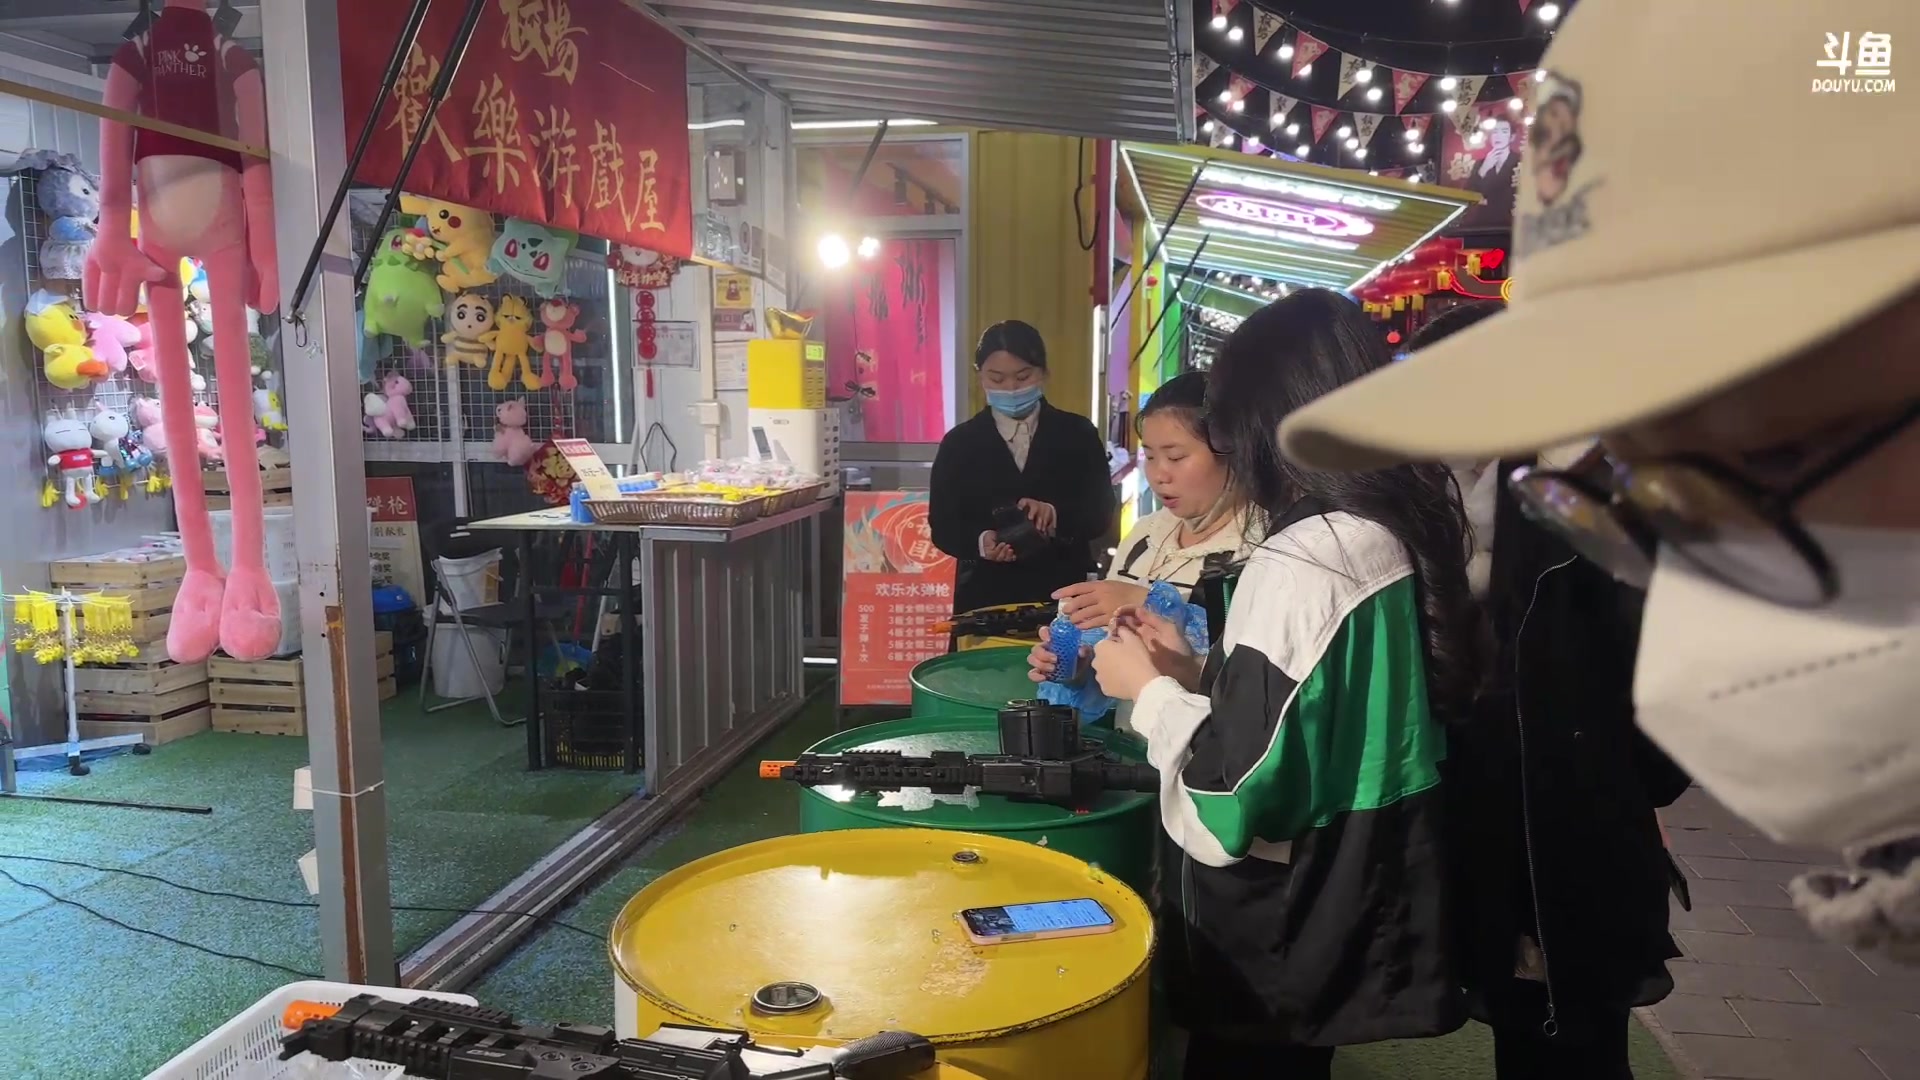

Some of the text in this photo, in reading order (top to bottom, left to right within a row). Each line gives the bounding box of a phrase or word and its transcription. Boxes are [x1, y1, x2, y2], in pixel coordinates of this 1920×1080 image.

[875, 583, 950, 597] 欢乐水弹枪
